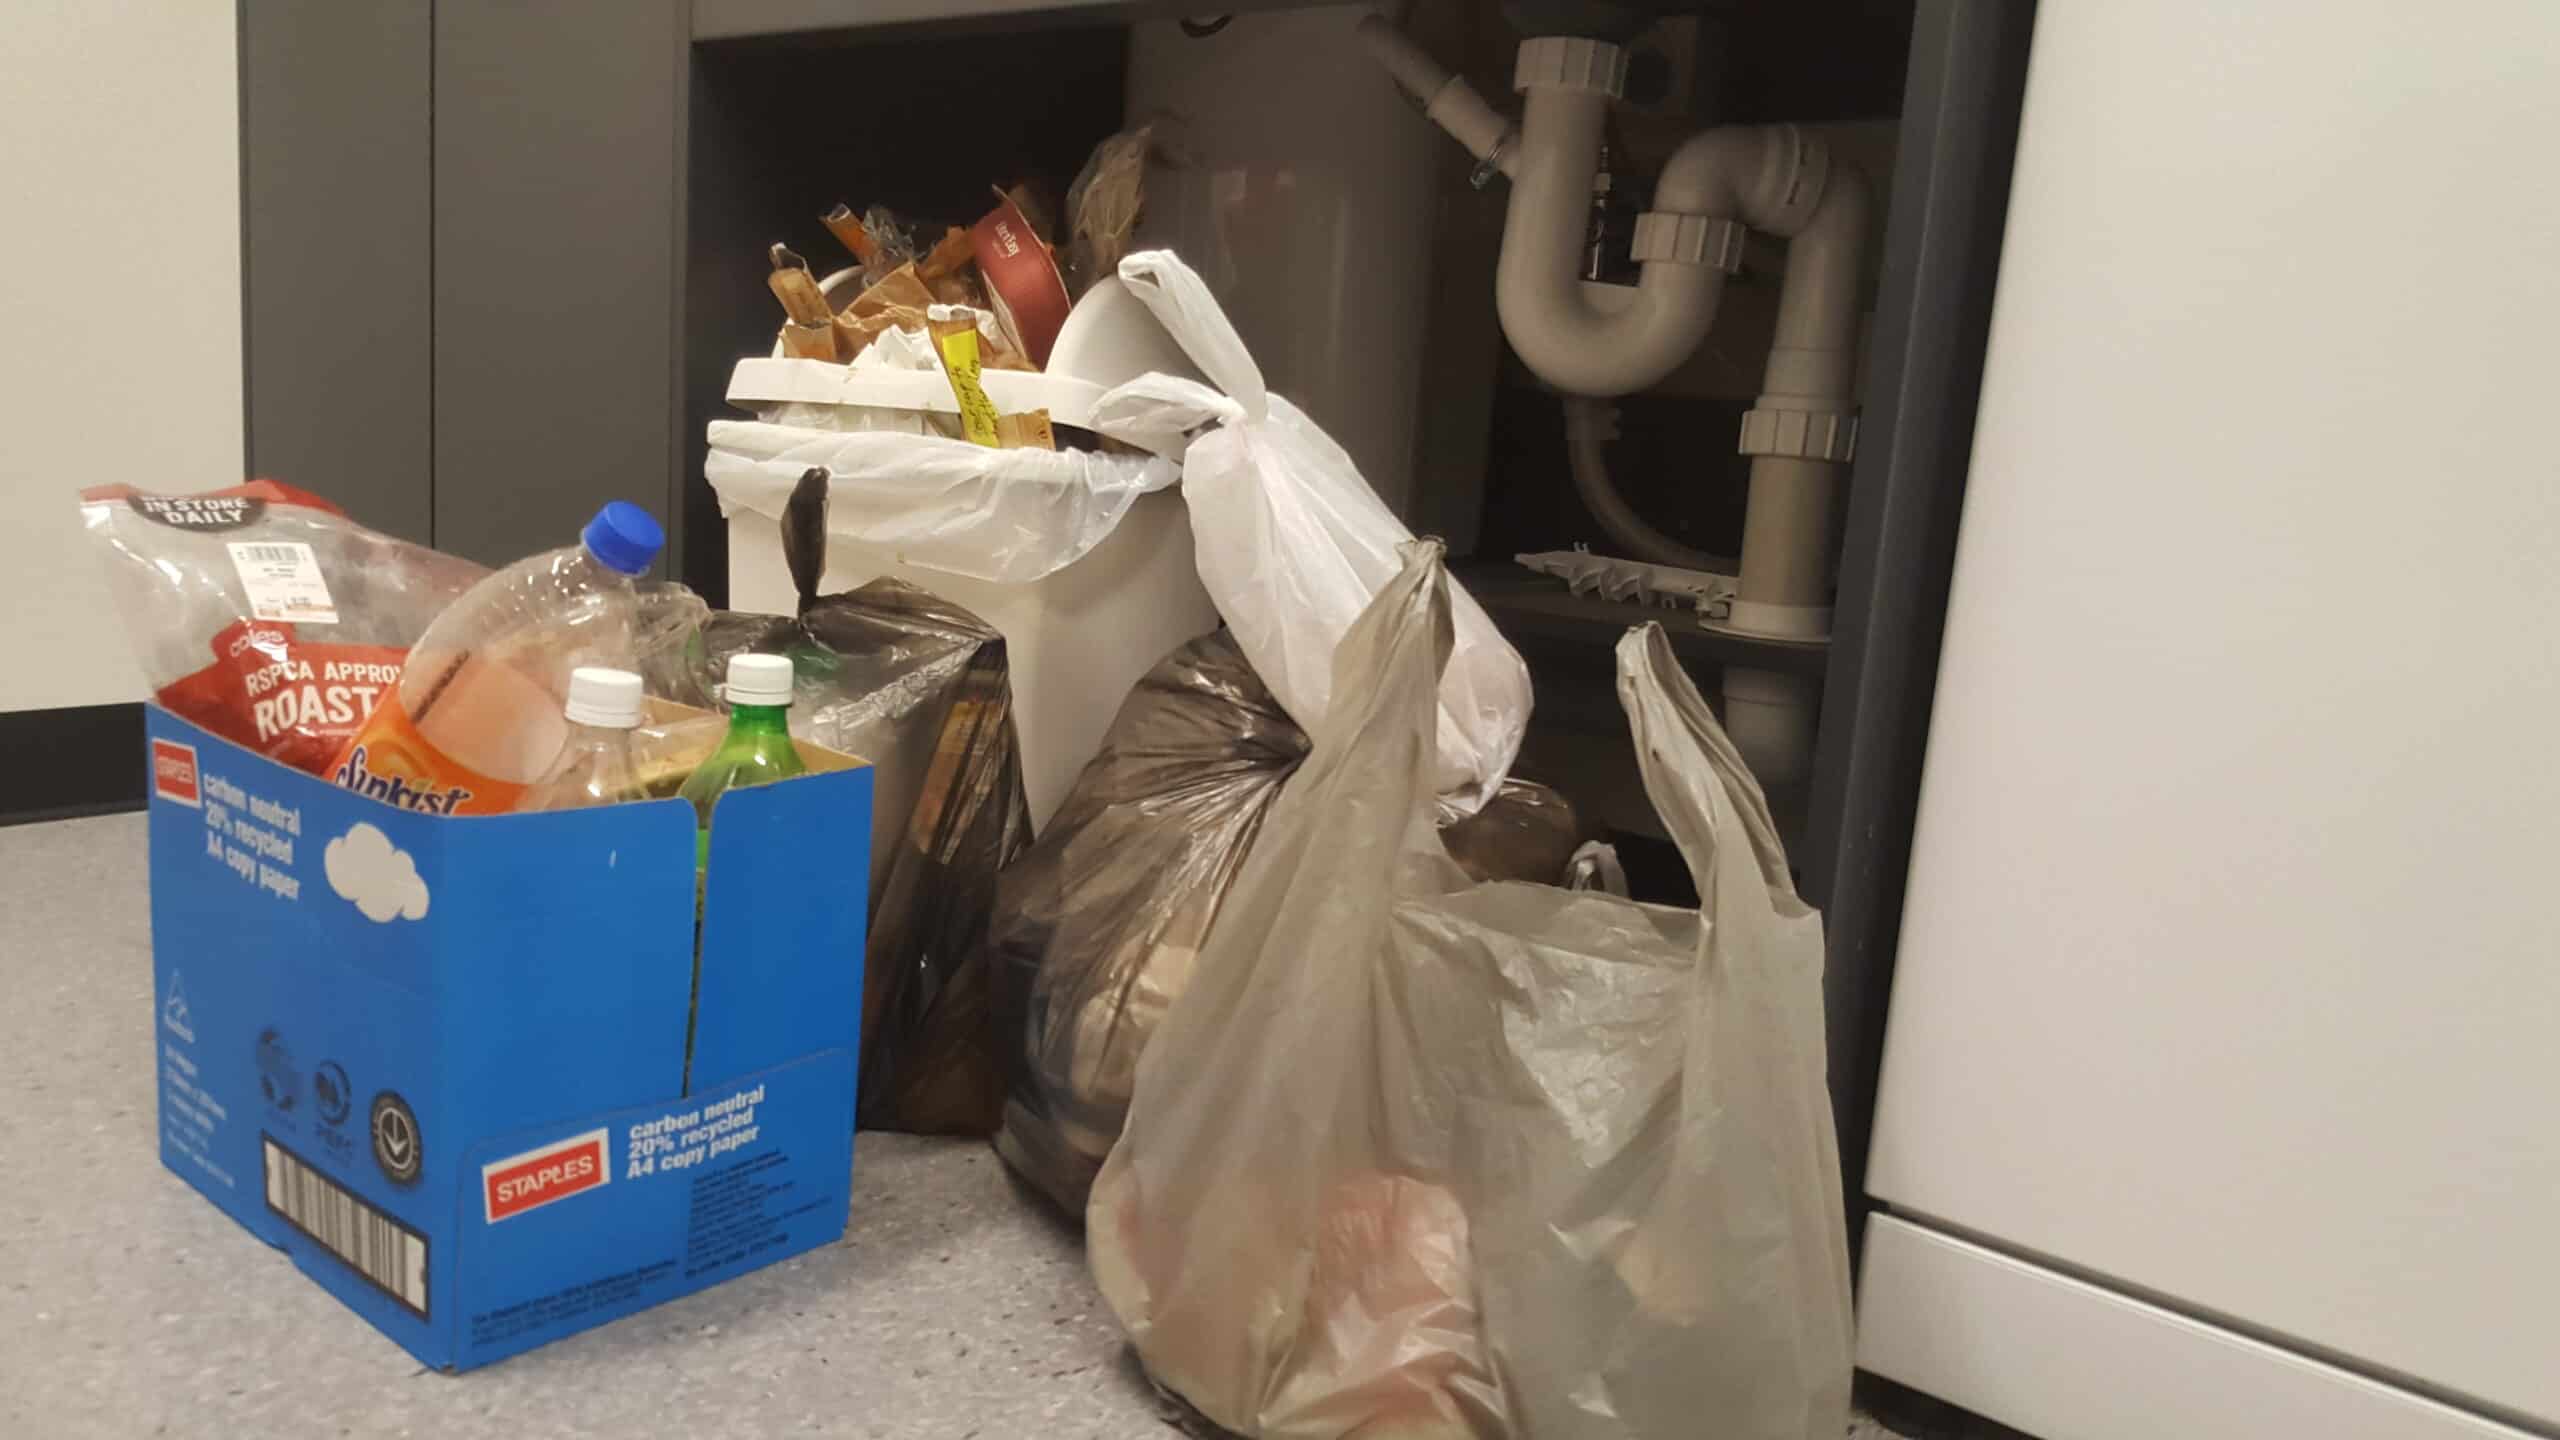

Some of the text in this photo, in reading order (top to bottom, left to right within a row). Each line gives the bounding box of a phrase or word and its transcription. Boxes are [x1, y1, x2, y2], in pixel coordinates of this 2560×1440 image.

[166, 510, 242, 523] DAILY
[245, 660, 400, 697] RSPCA APPRO
[254, 684, 378, 743] ROAST
[628, 1106, 754, 1160] 20% recycled
[629, 1083, 765, 1139] carbon neutral
[496, 1154, 594, 1203] STAPLES
[626, 1126, 760, 1180] A4 copy paper
